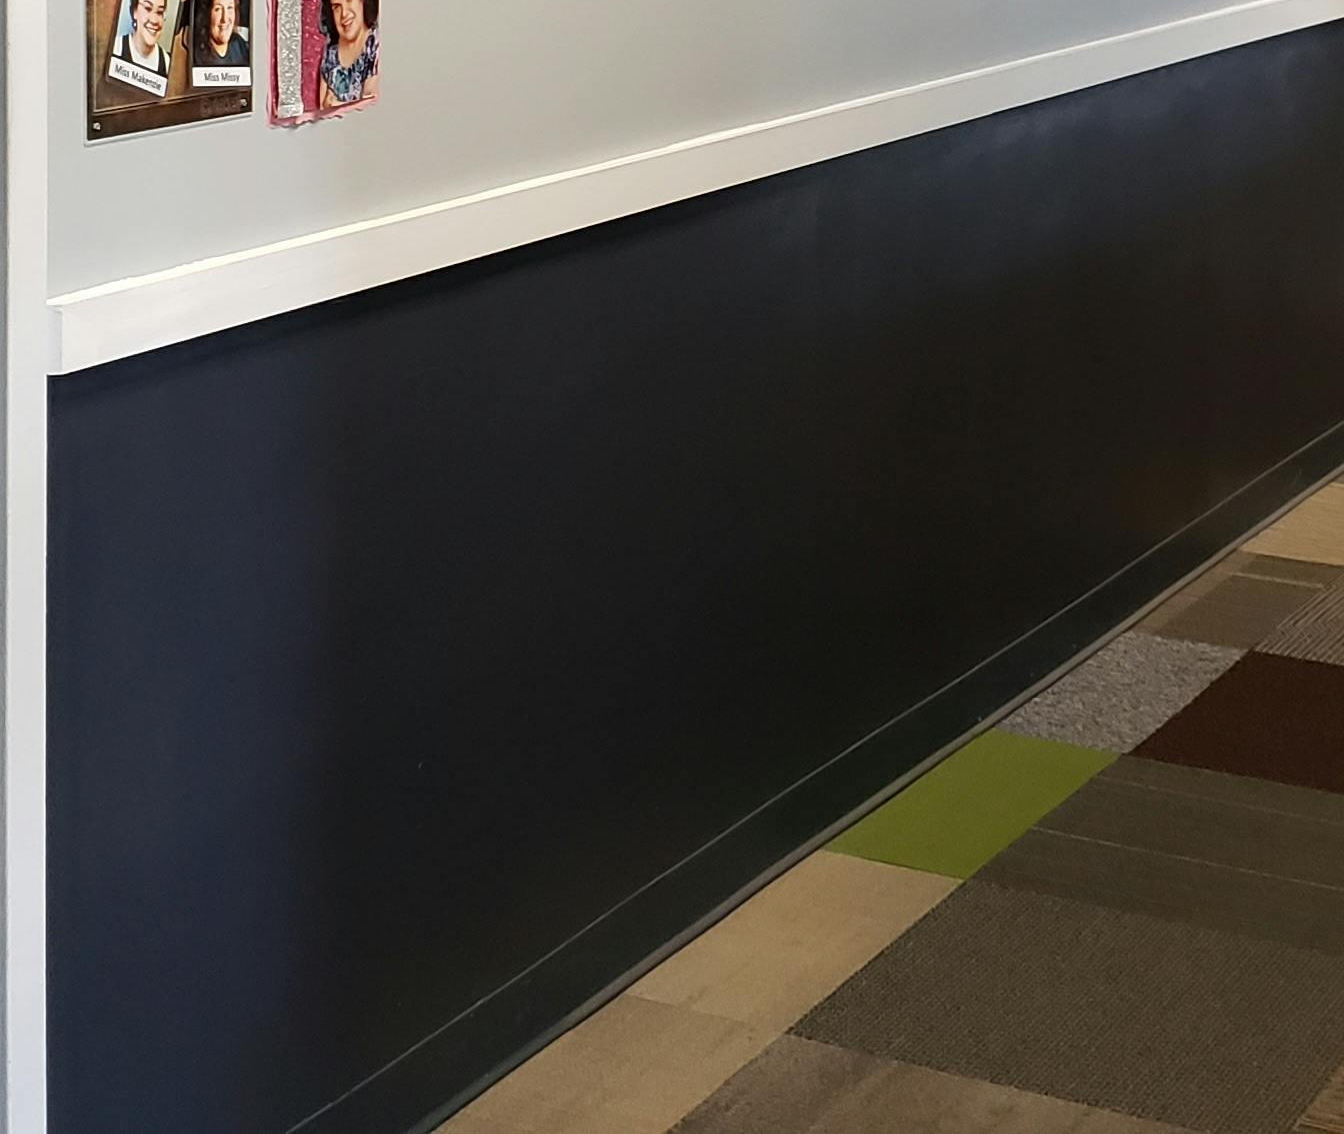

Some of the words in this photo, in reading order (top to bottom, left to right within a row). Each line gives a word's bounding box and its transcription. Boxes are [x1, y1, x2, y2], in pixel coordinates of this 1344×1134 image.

[114, 64, 130, 78] Miss
[203, 72, 219, 82] Miss
[220, 72, 241, 83] Missy
